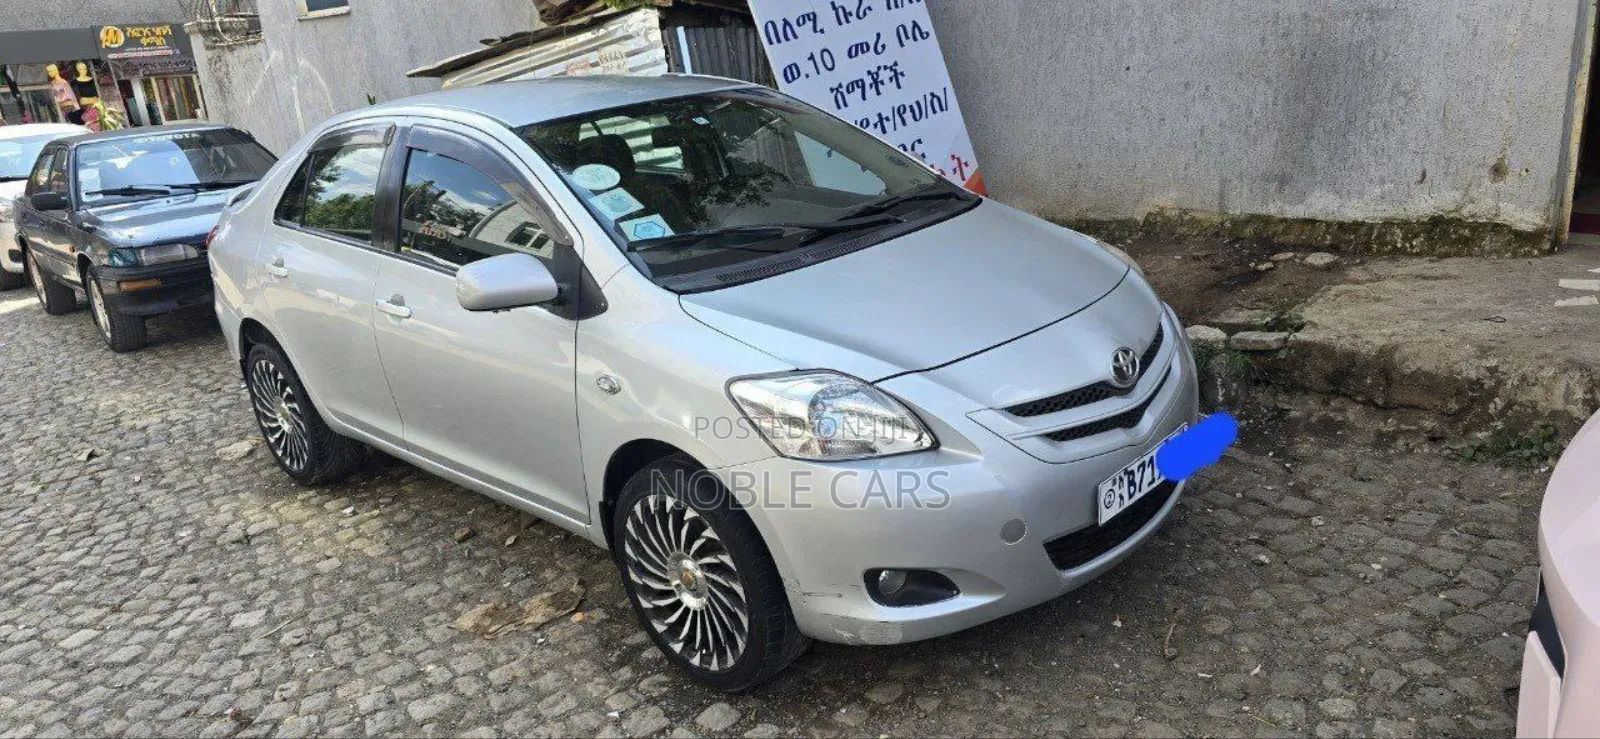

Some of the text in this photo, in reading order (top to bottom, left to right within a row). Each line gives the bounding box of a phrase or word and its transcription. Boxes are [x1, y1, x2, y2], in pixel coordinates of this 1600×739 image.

[764, 0, 873, 45] በለሚ ኩራ
[847, 32, 886, 59] መሪ
[896, 19, 930, 47] ቦሌ
[1127, 455, 1162, 500] B71
